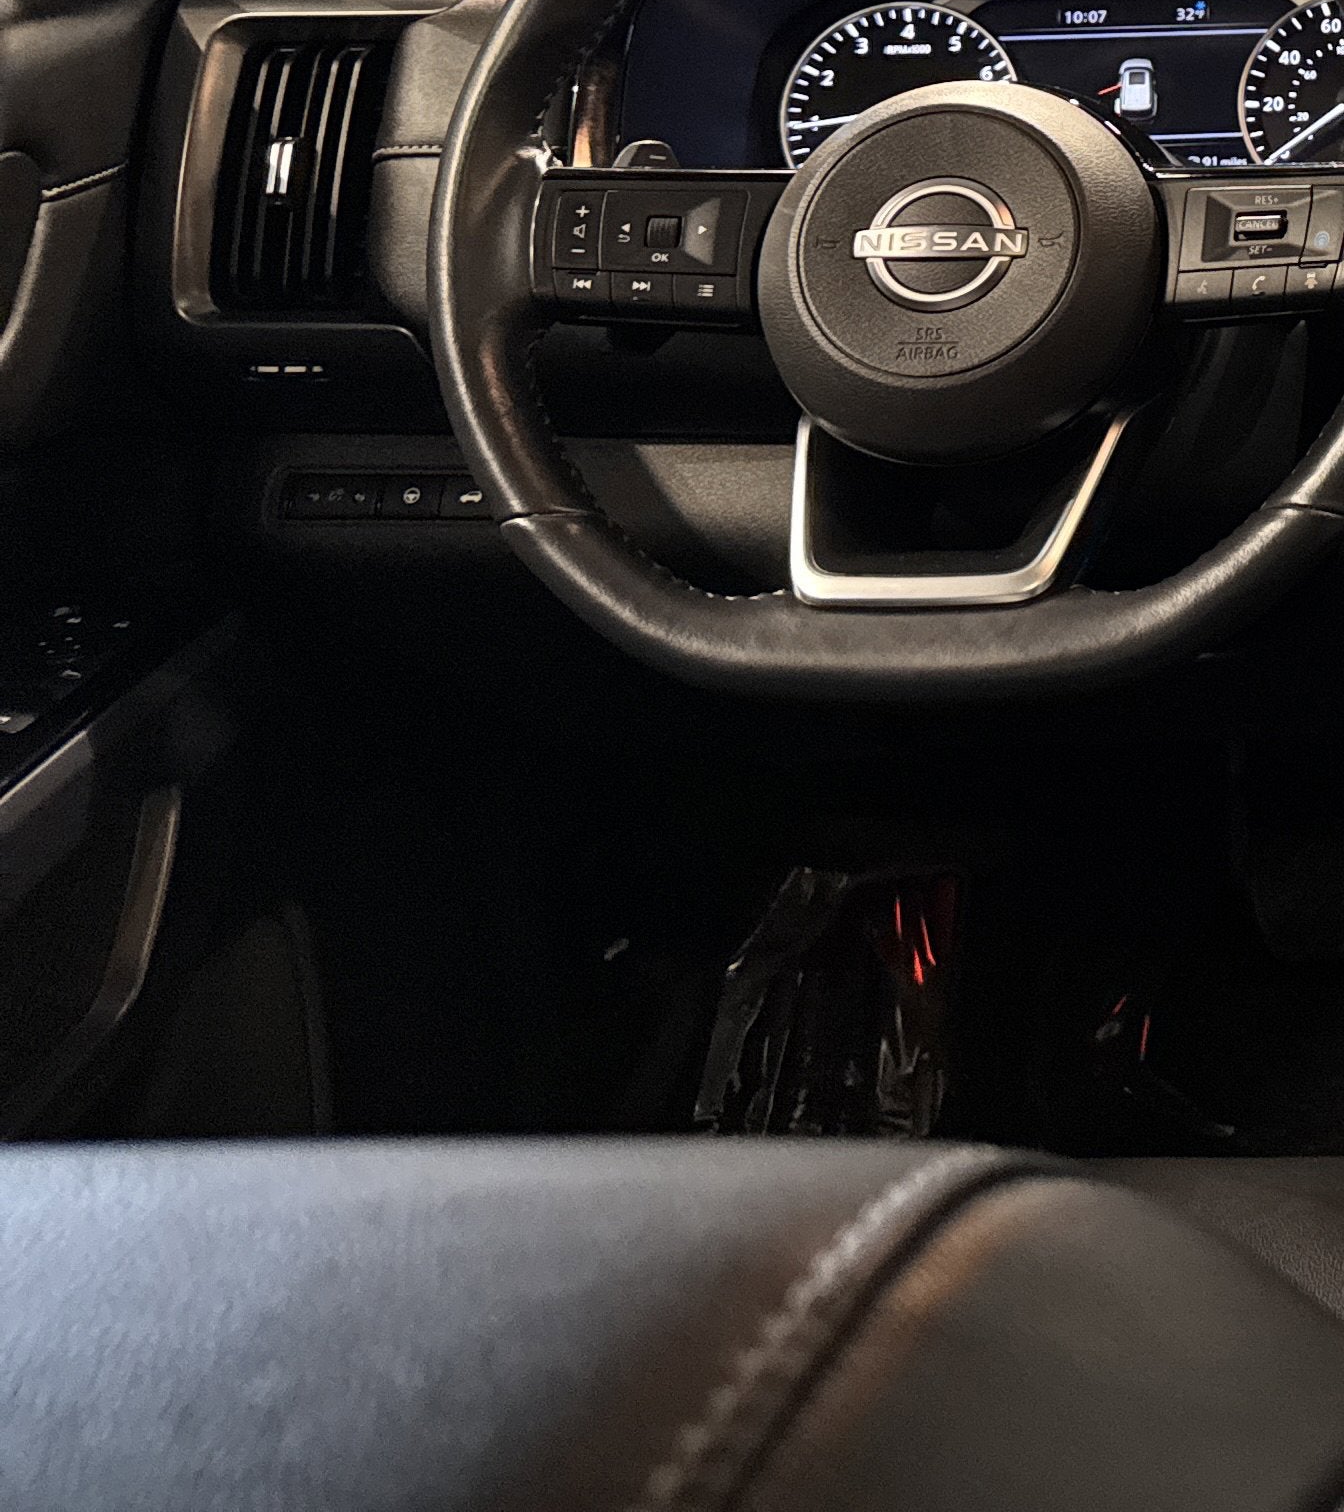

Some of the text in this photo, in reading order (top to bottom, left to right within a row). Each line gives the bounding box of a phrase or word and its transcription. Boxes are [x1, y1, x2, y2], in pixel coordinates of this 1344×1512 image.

[1064, 10, 1107, 24] 10:07
[900, 24, 915, 39] 4
[1320, 18, 1342, 33] 60
[854, 37, 869, 55] 3
[948, 36, 961, 52] 5
[1278, 50, 1301, 65] 40
[820, 69, 835, 87] 2
[979, 65, 993, 81] 6
[1262, 96, 1285, 112] 20
[1296, 112, 1309, 122] 20
[1220, 156, 1247, 166] miles
[1237, 220, 1279, 229] CANCEL
[860, 231, 1022, 252] NISSAN
[651, 253, 669, 263] OK
[915, 327, 943, 339] SRS
[896, 345, 958, 361] AIRBAG
